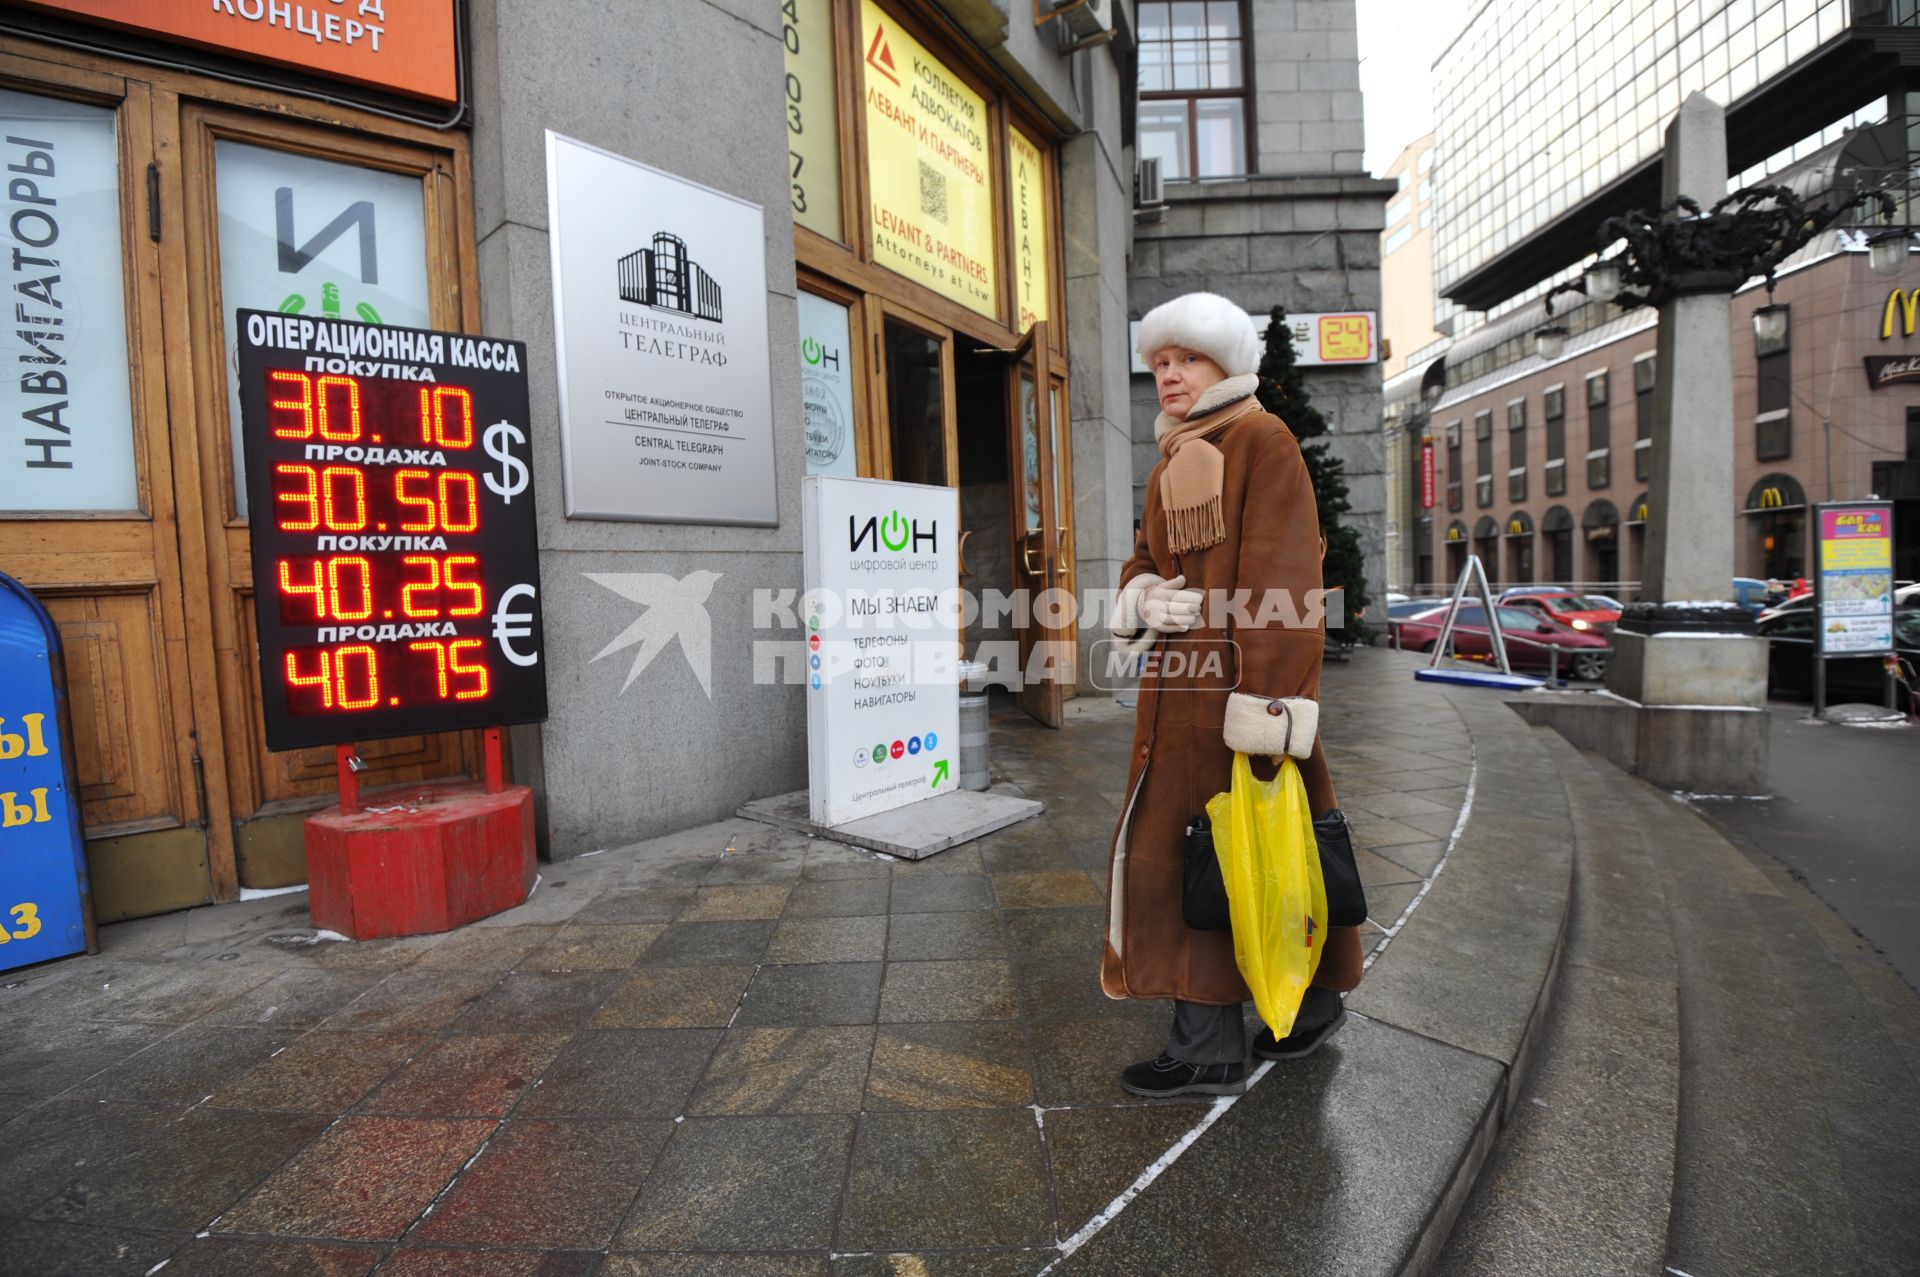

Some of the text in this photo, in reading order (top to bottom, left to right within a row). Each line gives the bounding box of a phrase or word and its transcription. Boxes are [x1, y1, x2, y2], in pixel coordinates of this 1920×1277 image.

[213, 0, 385, 51] КОНЦЕРТ
[913, 56, 975, 121] КОЛЛЕГИЯ
[911, 84, 982, 152] АДВОКАТОВ
[868, 86, 984, 186] ЛЕВАНТ И ПАРТНЕРЫ
[874, 204, 988, 284] LEVANT & PARTNERS
[876, 233, 989, 302] Attorneys at Law
[6, 135, 73, 469] НАВИГАТОРЫ
[248, 314, 520, 372] ОПЕРАЦИОННАЯ КАССА
[620, 312, 725, 345] ЦЕНТРАЛЬНЫЙ
[1326, 321, 1363, 344] 24
[619, 331, 727, 367] ТЕЛЕГРАФ
[305, 357, 436, 382] ПОКУПКА
[604, 390, 744, 418] ОТКРЫТОЕ АКЦИОНЕРНОЕ ОБЩЕСТВО
[625, 408, 730, 432] ЦЕНТРАЛЬНЫЙ ТЕЛЕГРАФ
[305, 445, 447, 466] ПРОДАЖА
[635, 435, 724, 455] CENTRAL TELEGRAPH
[482, 420, 529, 504] $
[639, 457, 722, 472] JOINT-STOCK COMPANY
[276, 464, 478, 532] 30.50
[317, 536, 447, 551] ПОКУПКА
[850, 559, 938, 574] цифровой центр
[279, 556, 483, 620] 40.25
[851, 595, 938, 615] МЫ ЗНАЕМ
[317, 622, 457, 642] ПРОДАЖА
[492, 583, 537, 666] €
[853, 634, 908, 649] ТЕЛЕФОНЫ
[286, 640, 489, 709] 40.75
[854, 656, 885, 669] ФОТО
[854, 691, 916, 710] НАВИГАТОРЫ
[852, 776, 926, 802] Центральный телеграф
